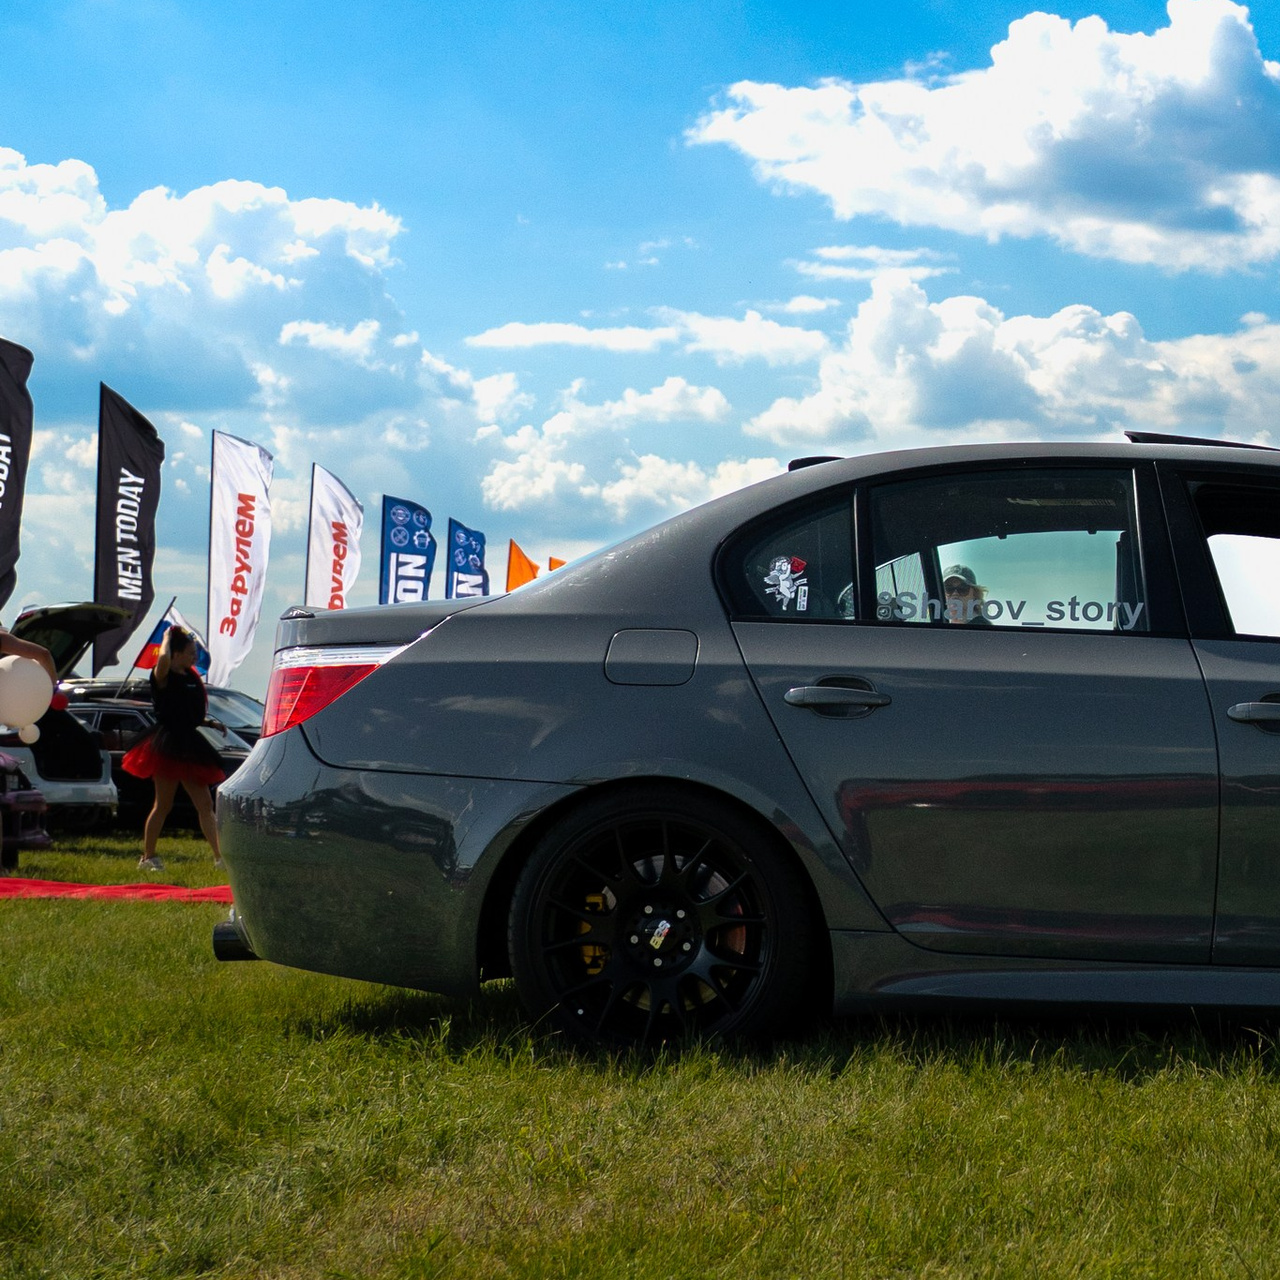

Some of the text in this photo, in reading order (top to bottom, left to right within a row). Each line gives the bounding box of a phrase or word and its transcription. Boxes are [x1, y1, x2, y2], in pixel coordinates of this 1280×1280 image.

[115, 467, 146, 601] MEN TODAY
[893, 591, 1145, 630] Sharov_story
